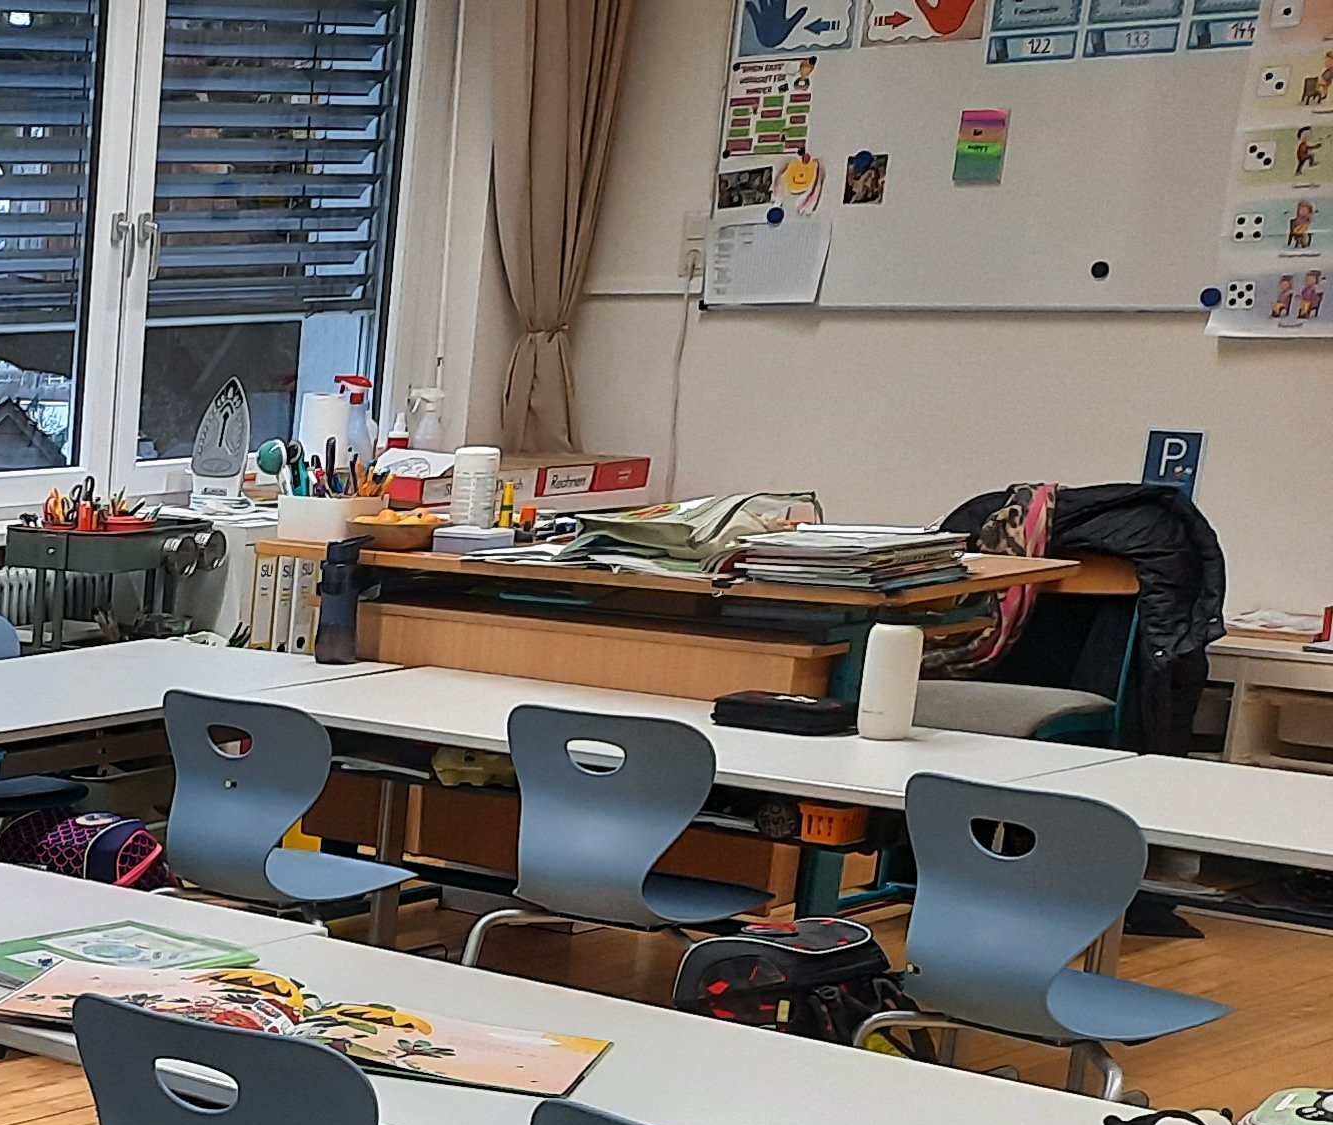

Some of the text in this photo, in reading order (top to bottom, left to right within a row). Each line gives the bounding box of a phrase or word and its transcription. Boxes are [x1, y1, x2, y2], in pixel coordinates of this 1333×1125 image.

[1027, 37, 1051, 55] 122
[1124, 31, 1150, 49] 133
[1158, 436, 1188, 477] P
[260, 563, 274, 577] SU
[301, 562, 315, 576] SU
